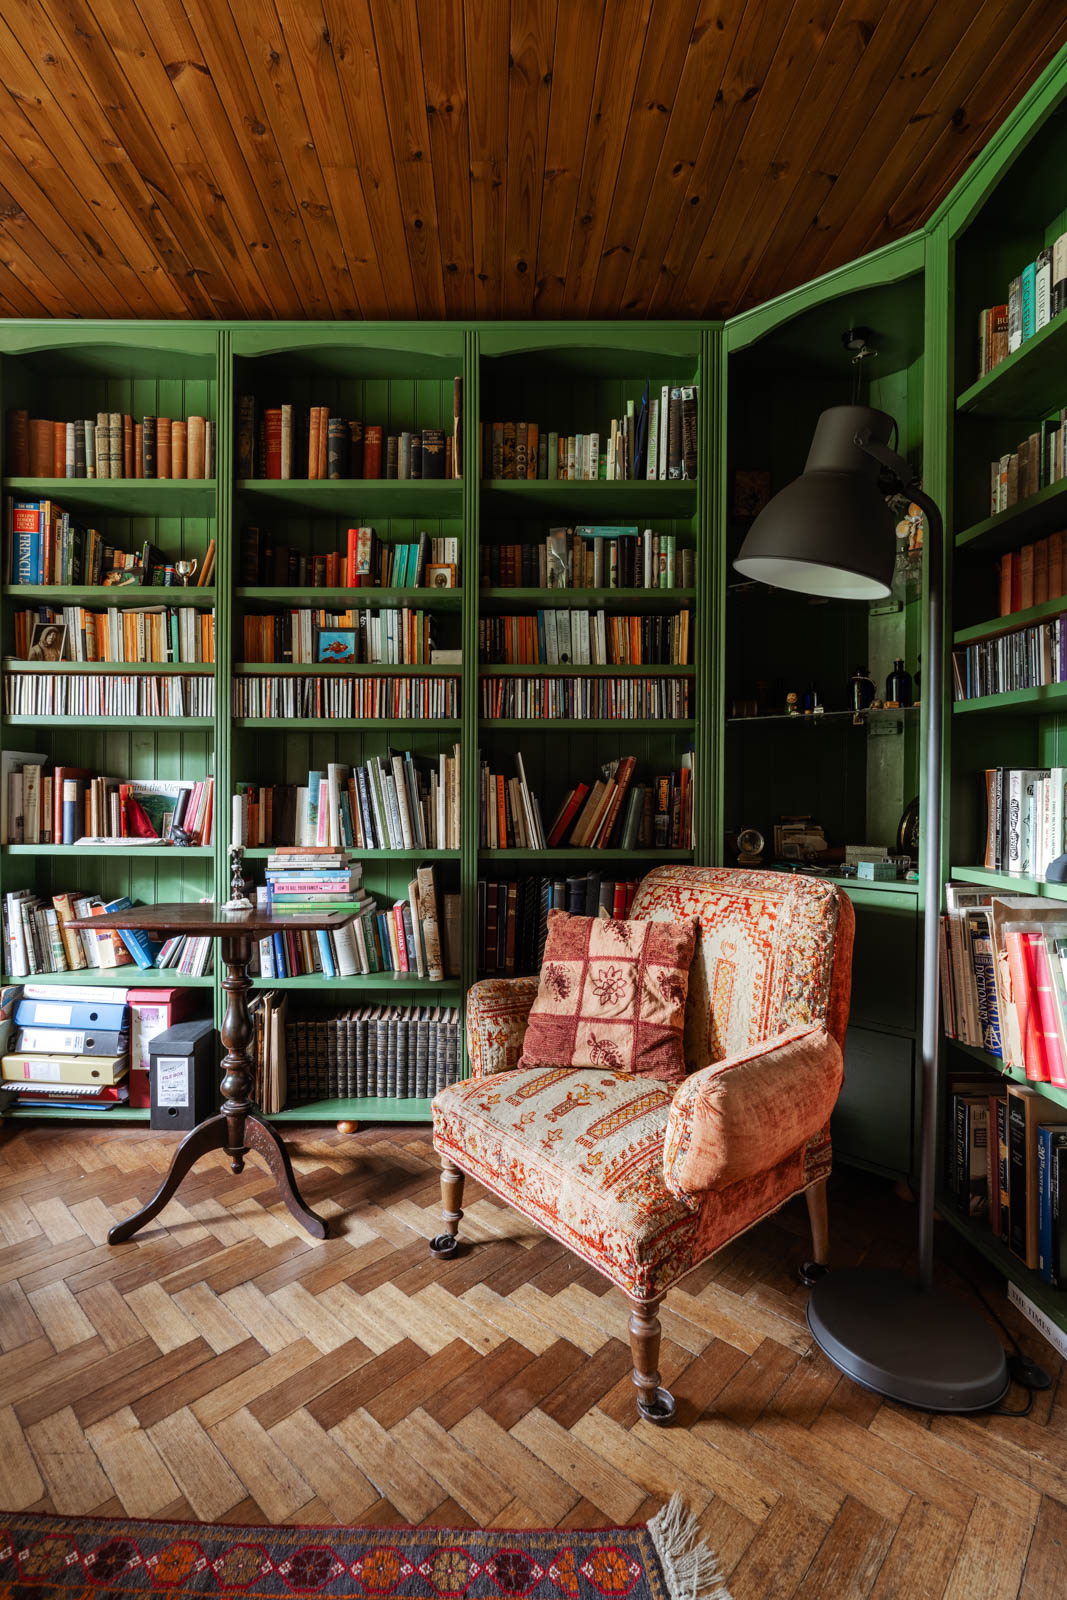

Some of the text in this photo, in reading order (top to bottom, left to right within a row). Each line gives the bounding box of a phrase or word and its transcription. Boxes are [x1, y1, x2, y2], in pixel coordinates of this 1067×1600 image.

[19, 534, 31, 577] FRENCH
[149, 784, 160, 792] the
[359, 773, 367, 798] WILLOW
[978, 964, 989, 1026] DICTIONARY
[984, 965, 1000, 1029] OXFORD
[1012, 1290, 1026, 1310] THE
[1028, 1307, 1051, 1336] TIMES
